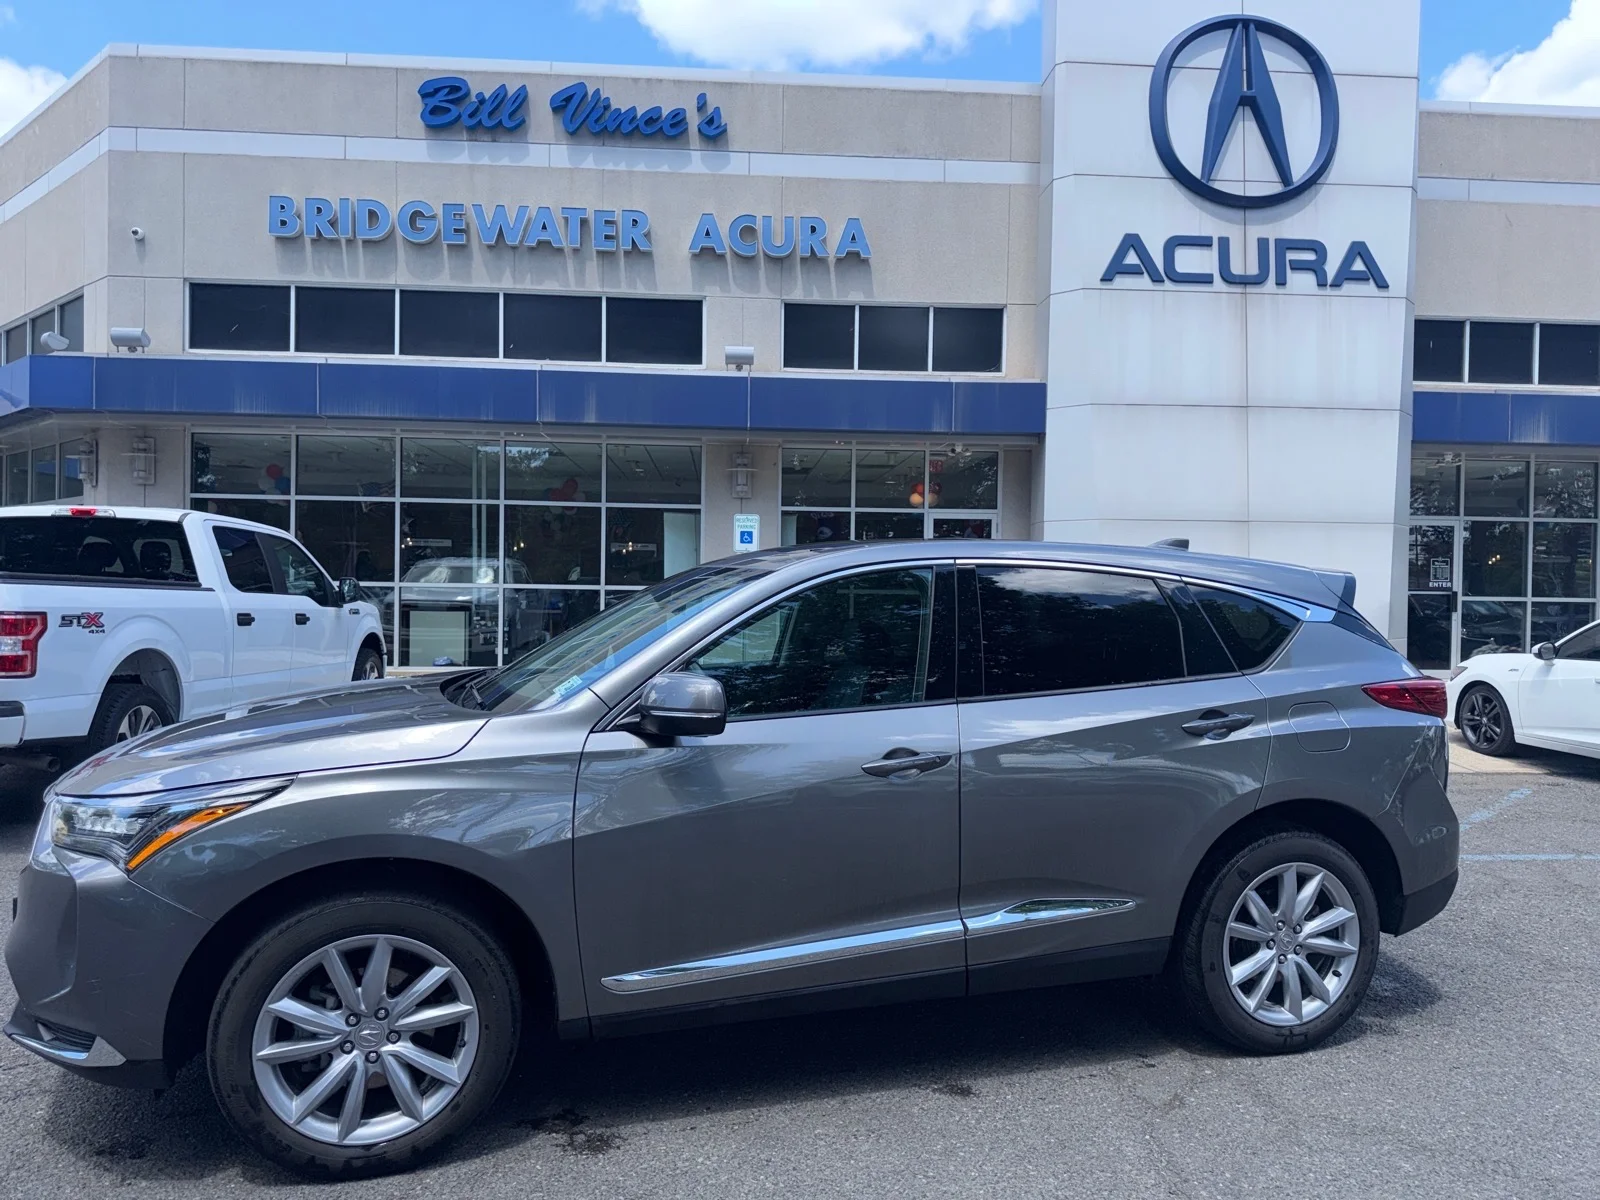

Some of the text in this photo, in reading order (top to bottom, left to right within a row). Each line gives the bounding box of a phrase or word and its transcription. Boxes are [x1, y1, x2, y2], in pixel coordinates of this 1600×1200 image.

[418, 76, 728, 141] Bill Vince's
[268, 195, 873, 260] BRIDGEWATER ACURA
[1099, 232, 1390, 289] ACURA
[58, 611, 105, 629] STX
